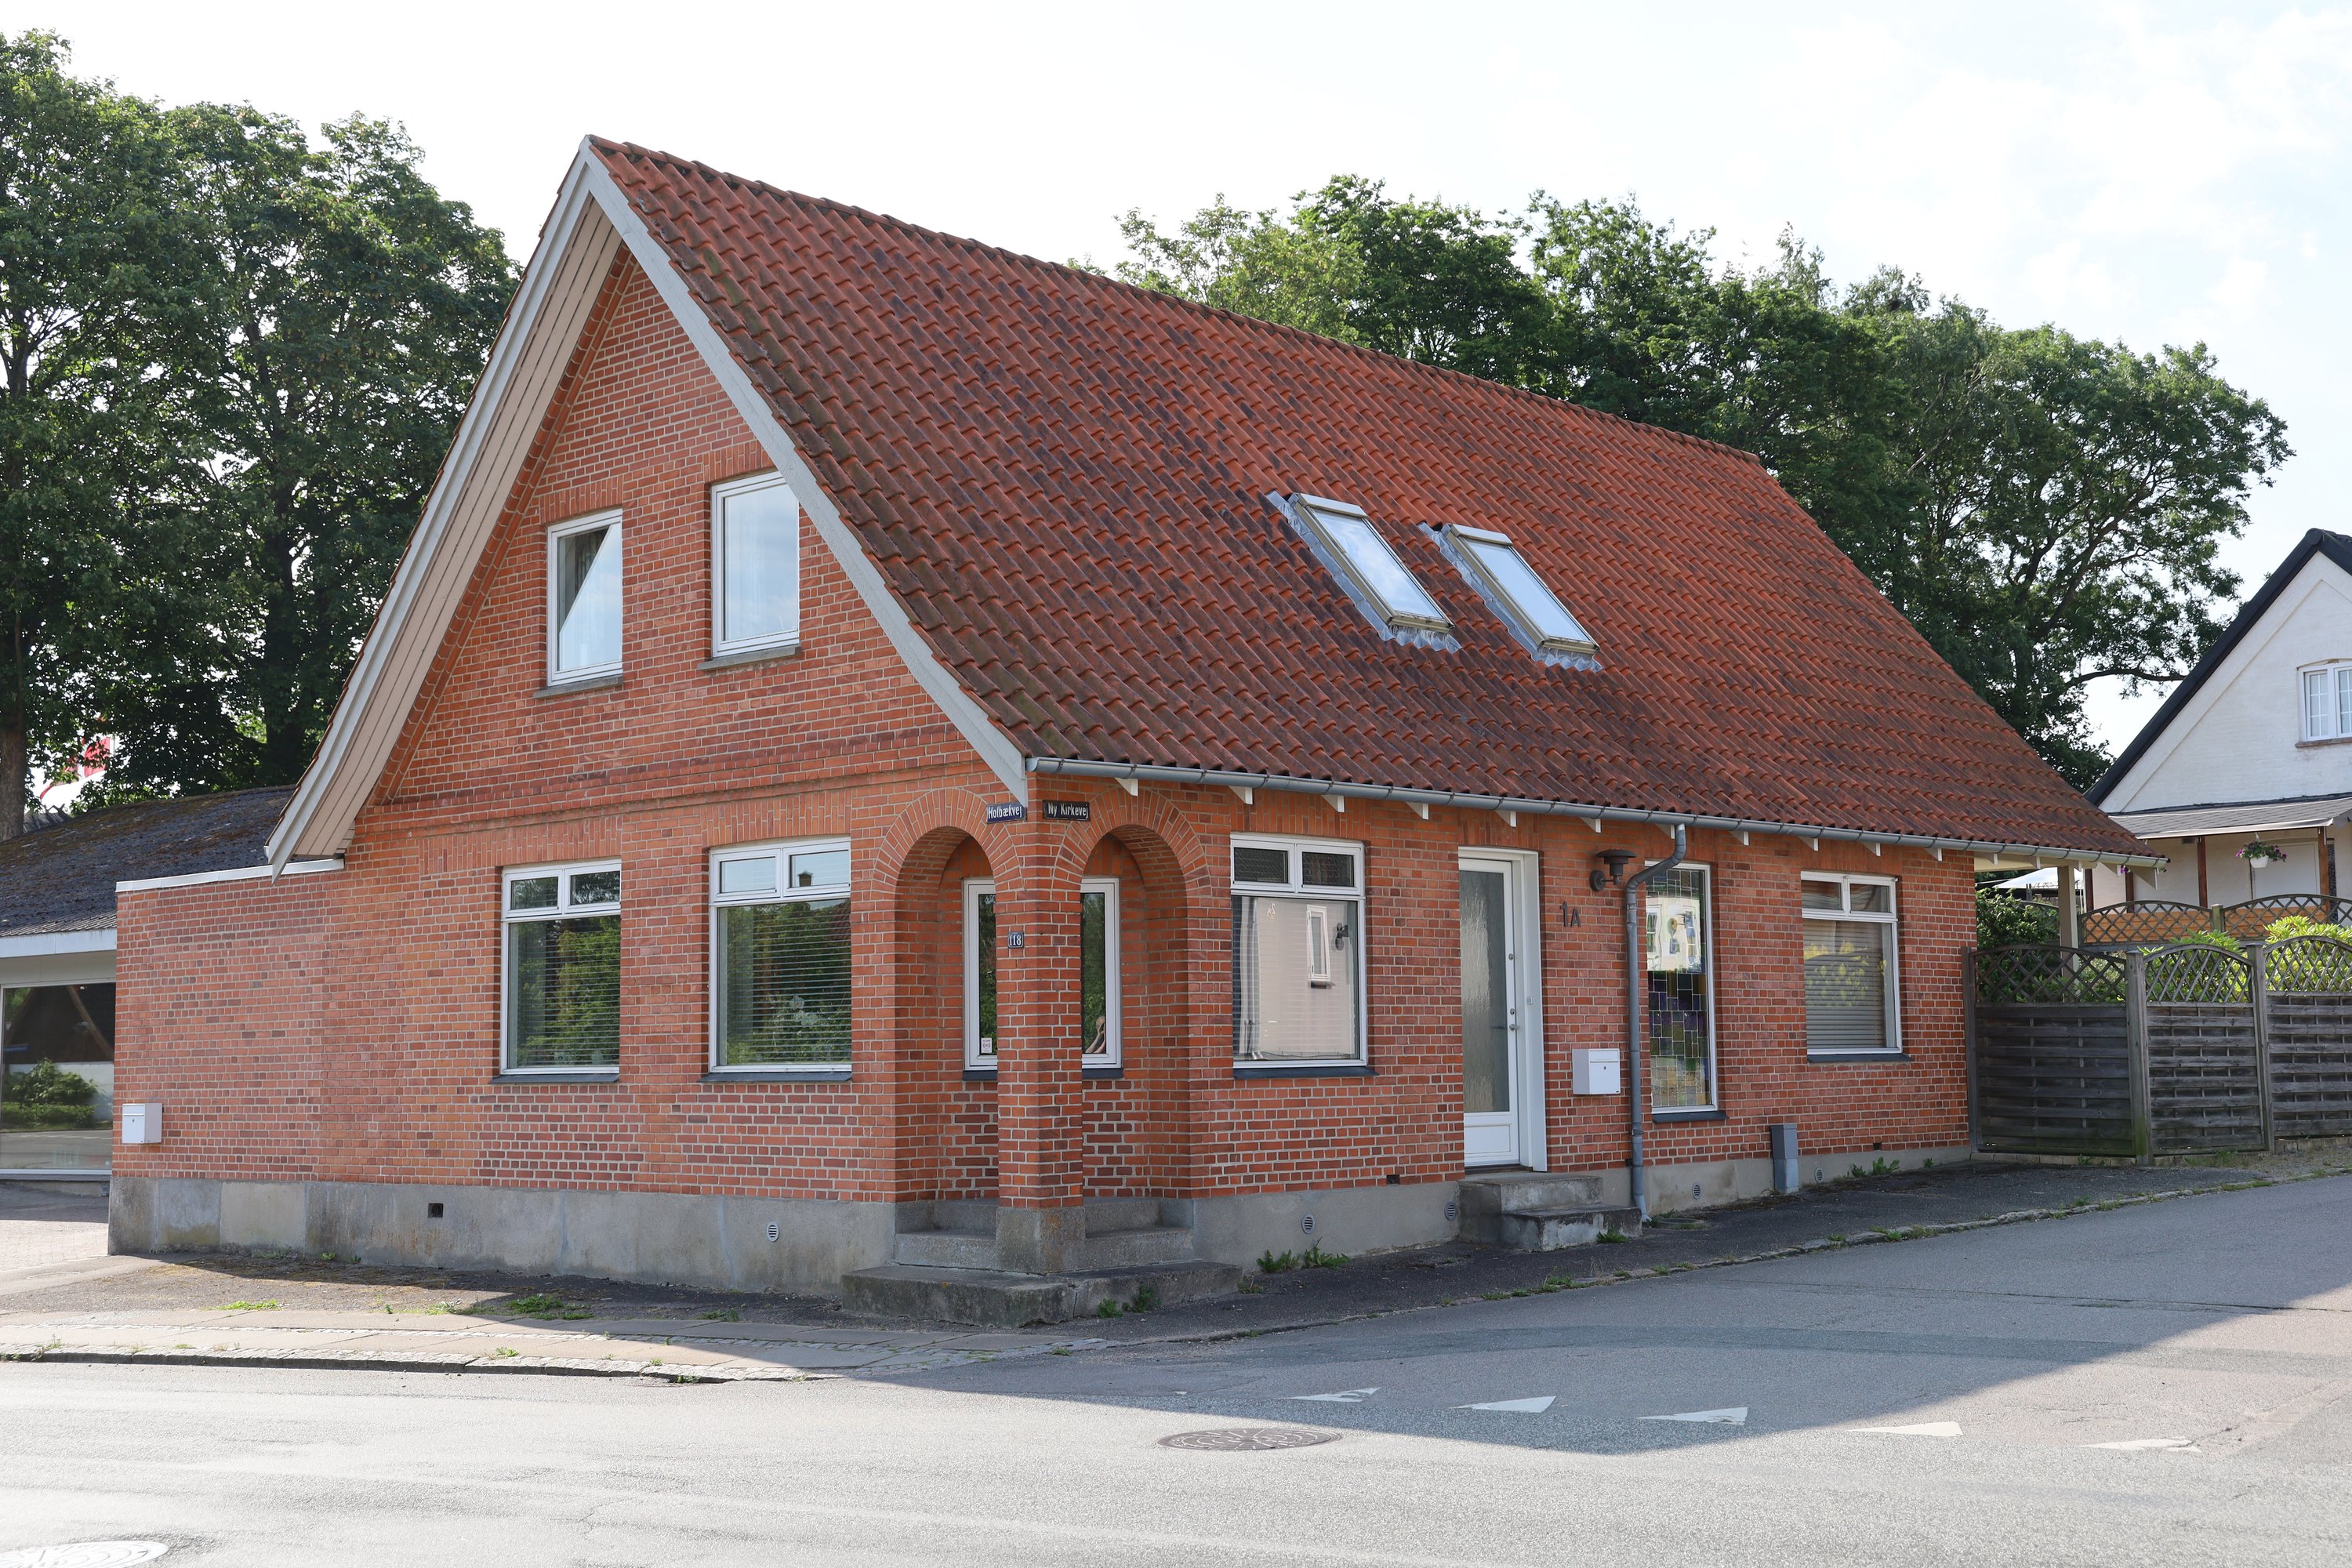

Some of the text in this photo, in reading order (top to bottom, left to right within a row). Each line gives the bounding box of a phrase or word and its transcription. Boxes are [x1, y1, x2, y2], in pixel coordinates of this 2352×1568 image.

[988, 804, 1022, 818] Holbækvej
[1047, 802, 1088, 819] Ny Kirkevej
[1559, 901, 1581, 927] 1A
[1009, 934, 1022, 946] 118
